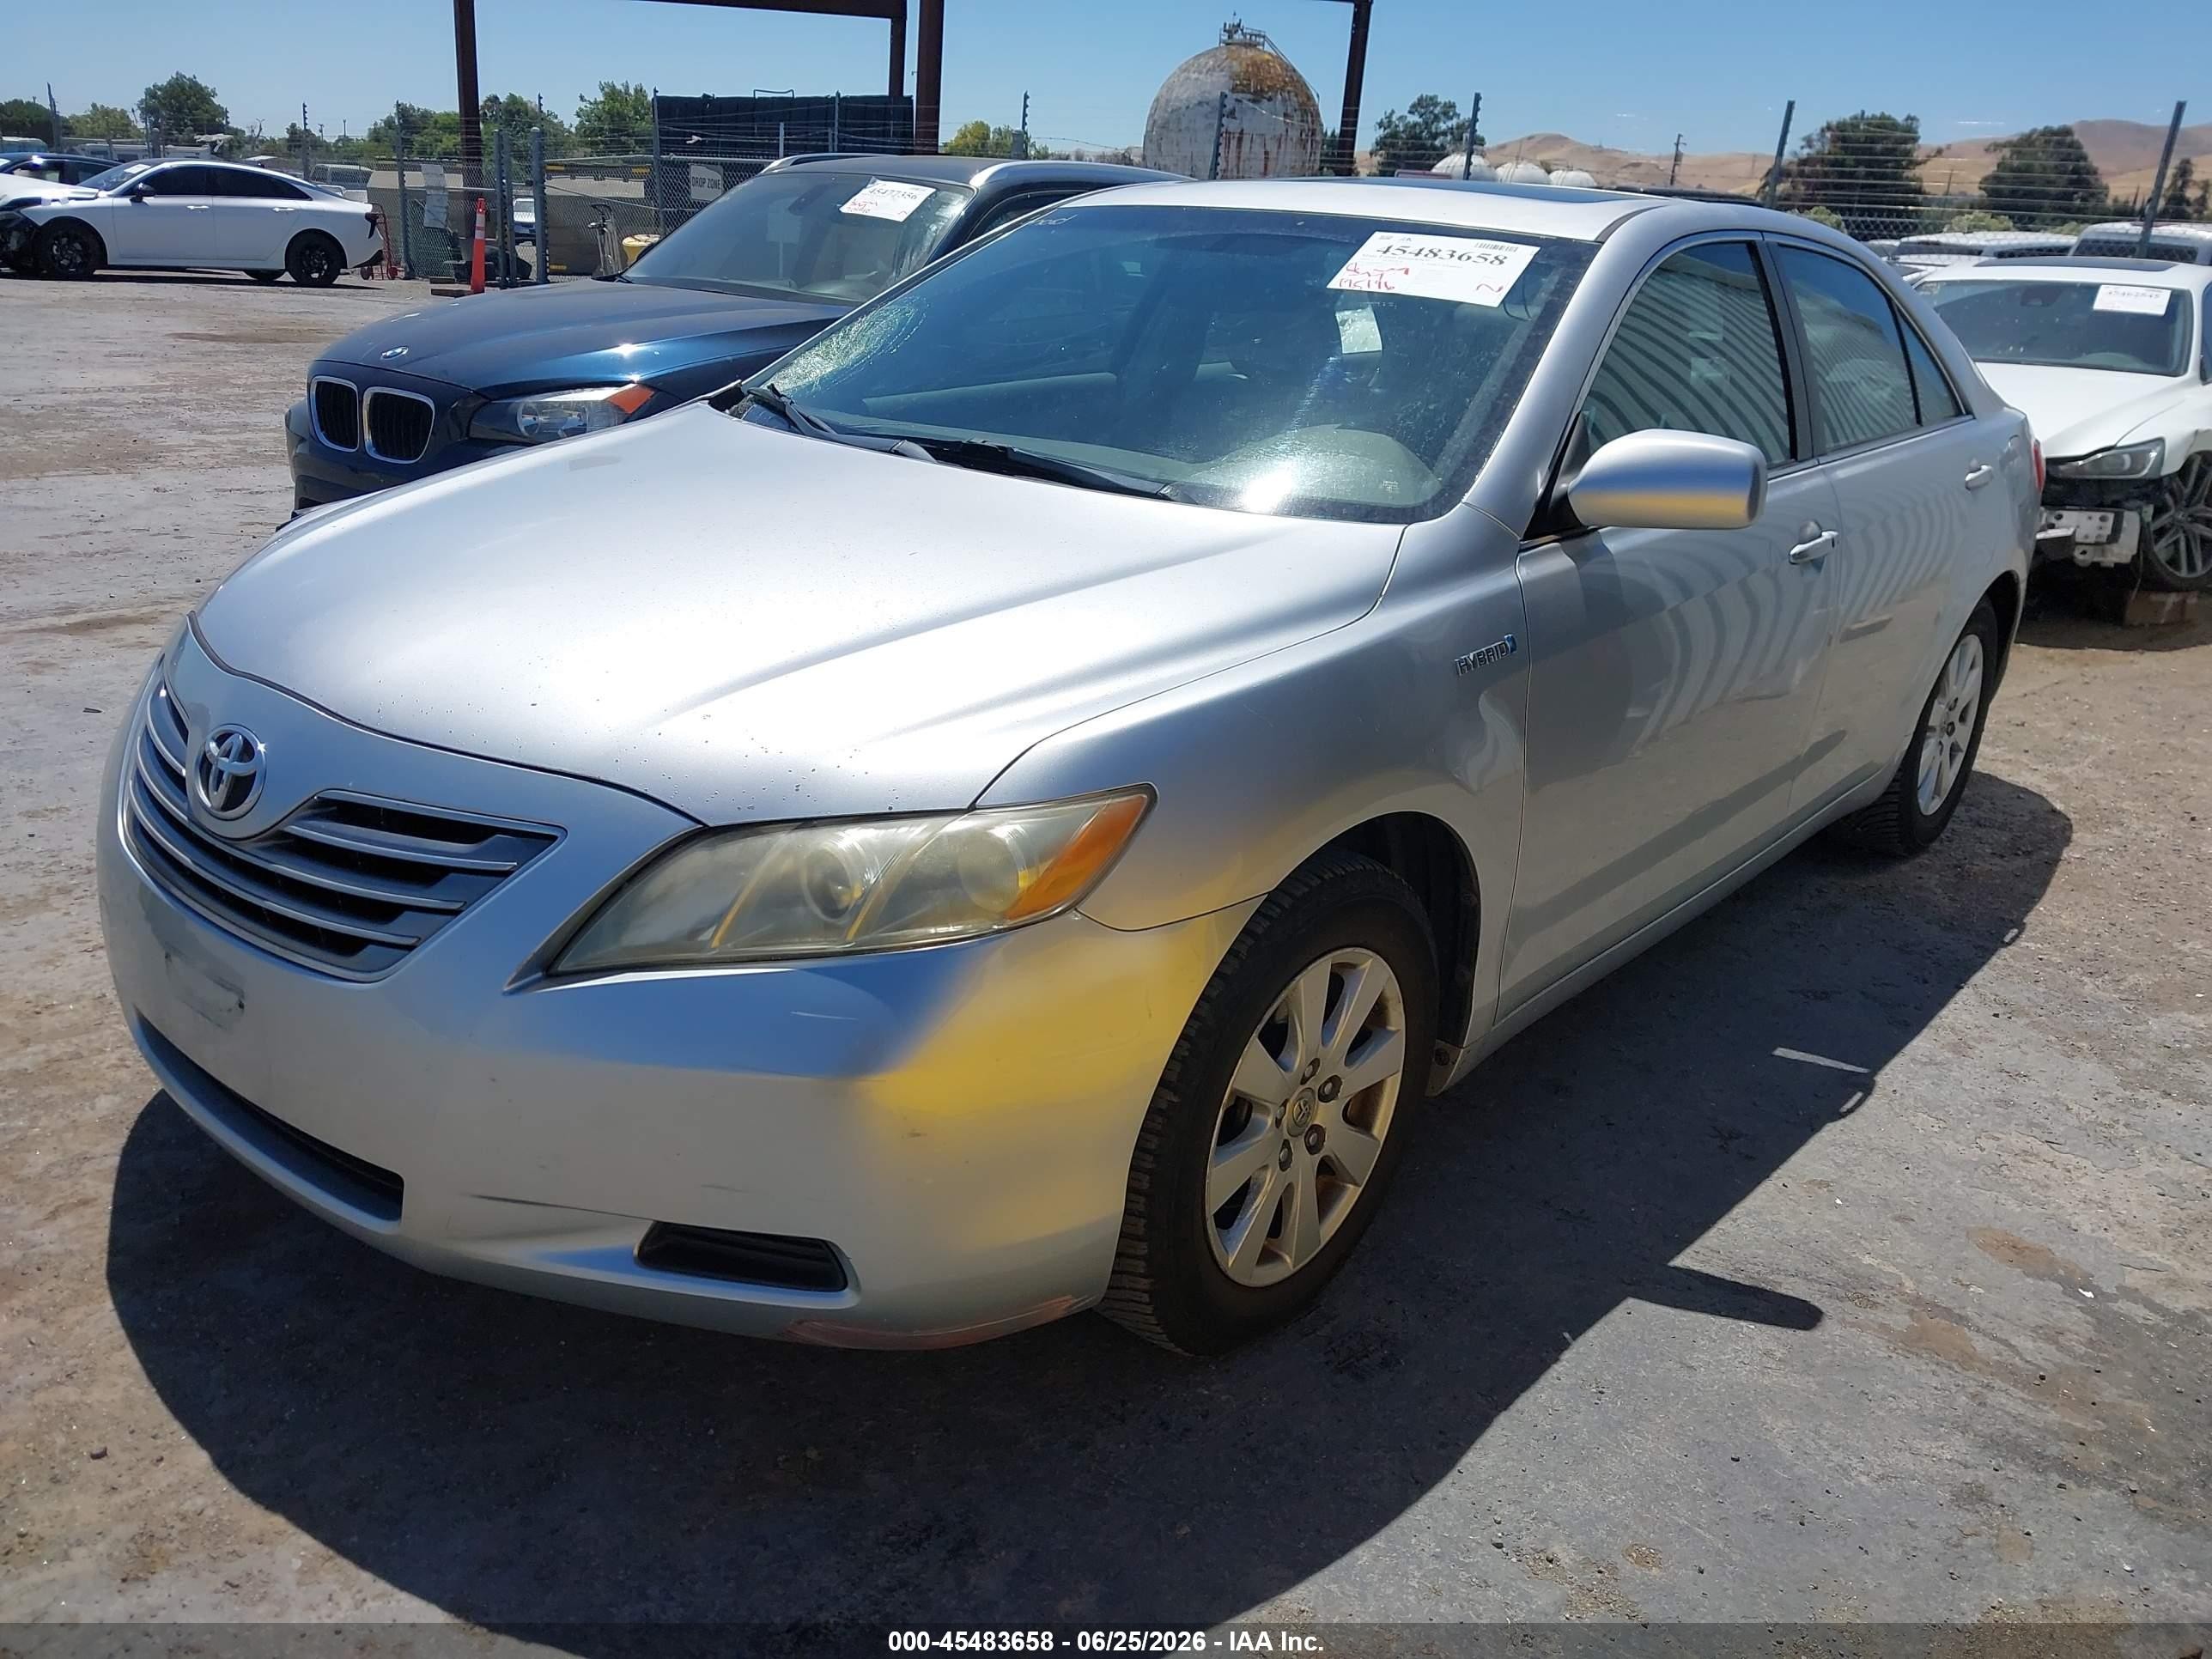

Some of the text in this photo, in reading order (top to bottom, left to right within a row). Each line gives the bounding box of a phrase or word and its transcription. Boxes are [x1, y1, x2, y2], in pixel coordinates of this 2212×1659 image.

[691, 176, 721, 190] DROP ZONE
[1376, 244, 1508, 266] 45483658
[1455, 641, 1510, 677] HYBRID
